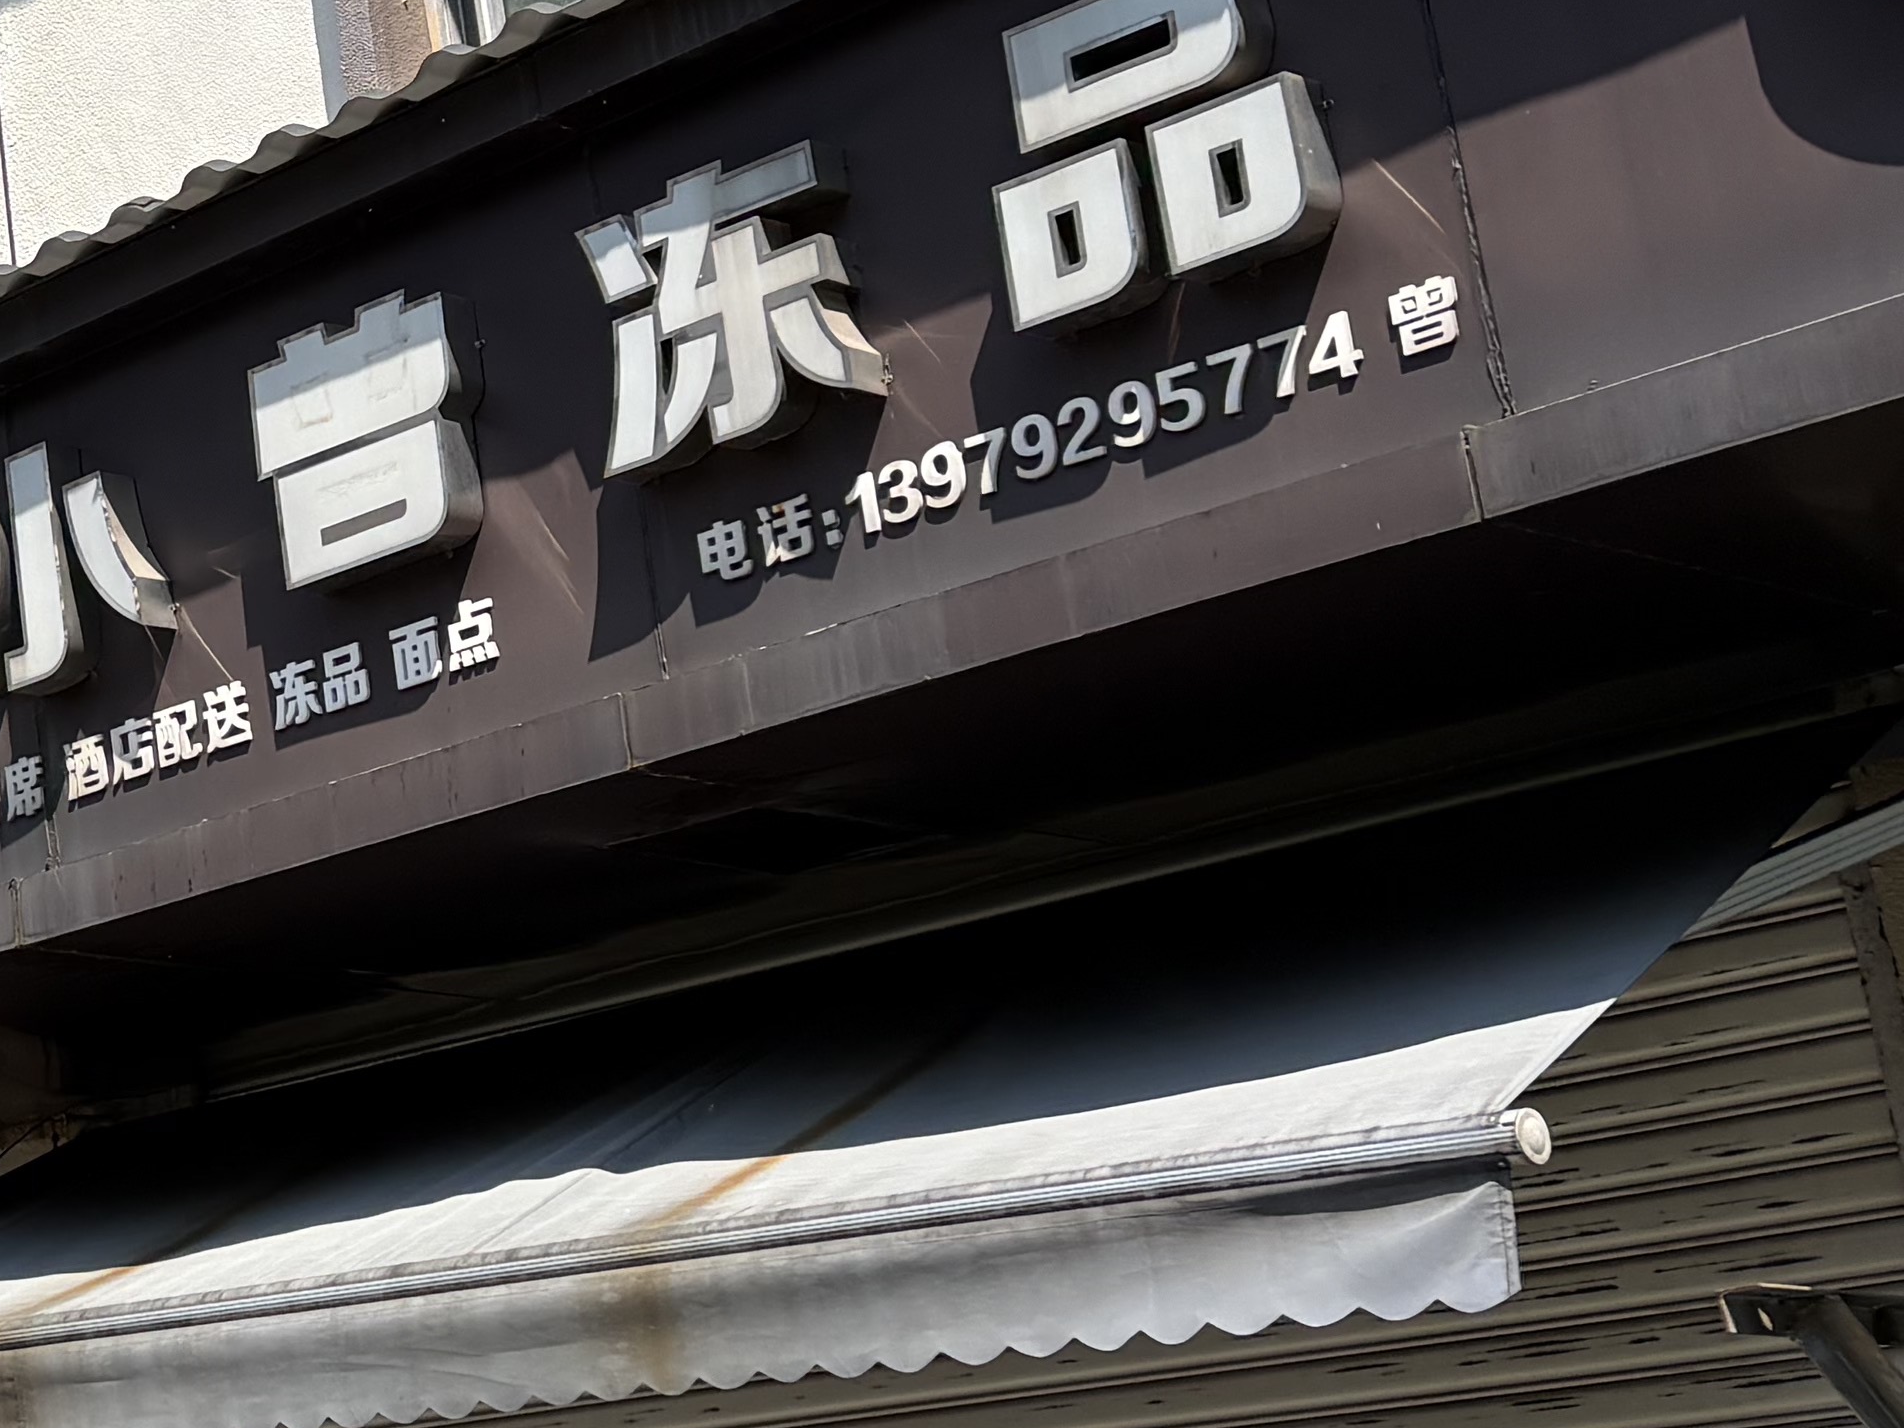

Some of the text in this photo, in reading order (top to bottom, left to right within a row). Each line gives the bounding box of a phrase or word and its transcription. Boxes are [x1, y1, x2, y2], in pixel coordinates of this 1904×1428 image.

[697, 275, 1459, 584] 电话:13979295774 曾
[63, 679, 254, 802] 酒店配送
[269, 641, 371, 732] 冻品
[389, 596, 501, 691] 面点
